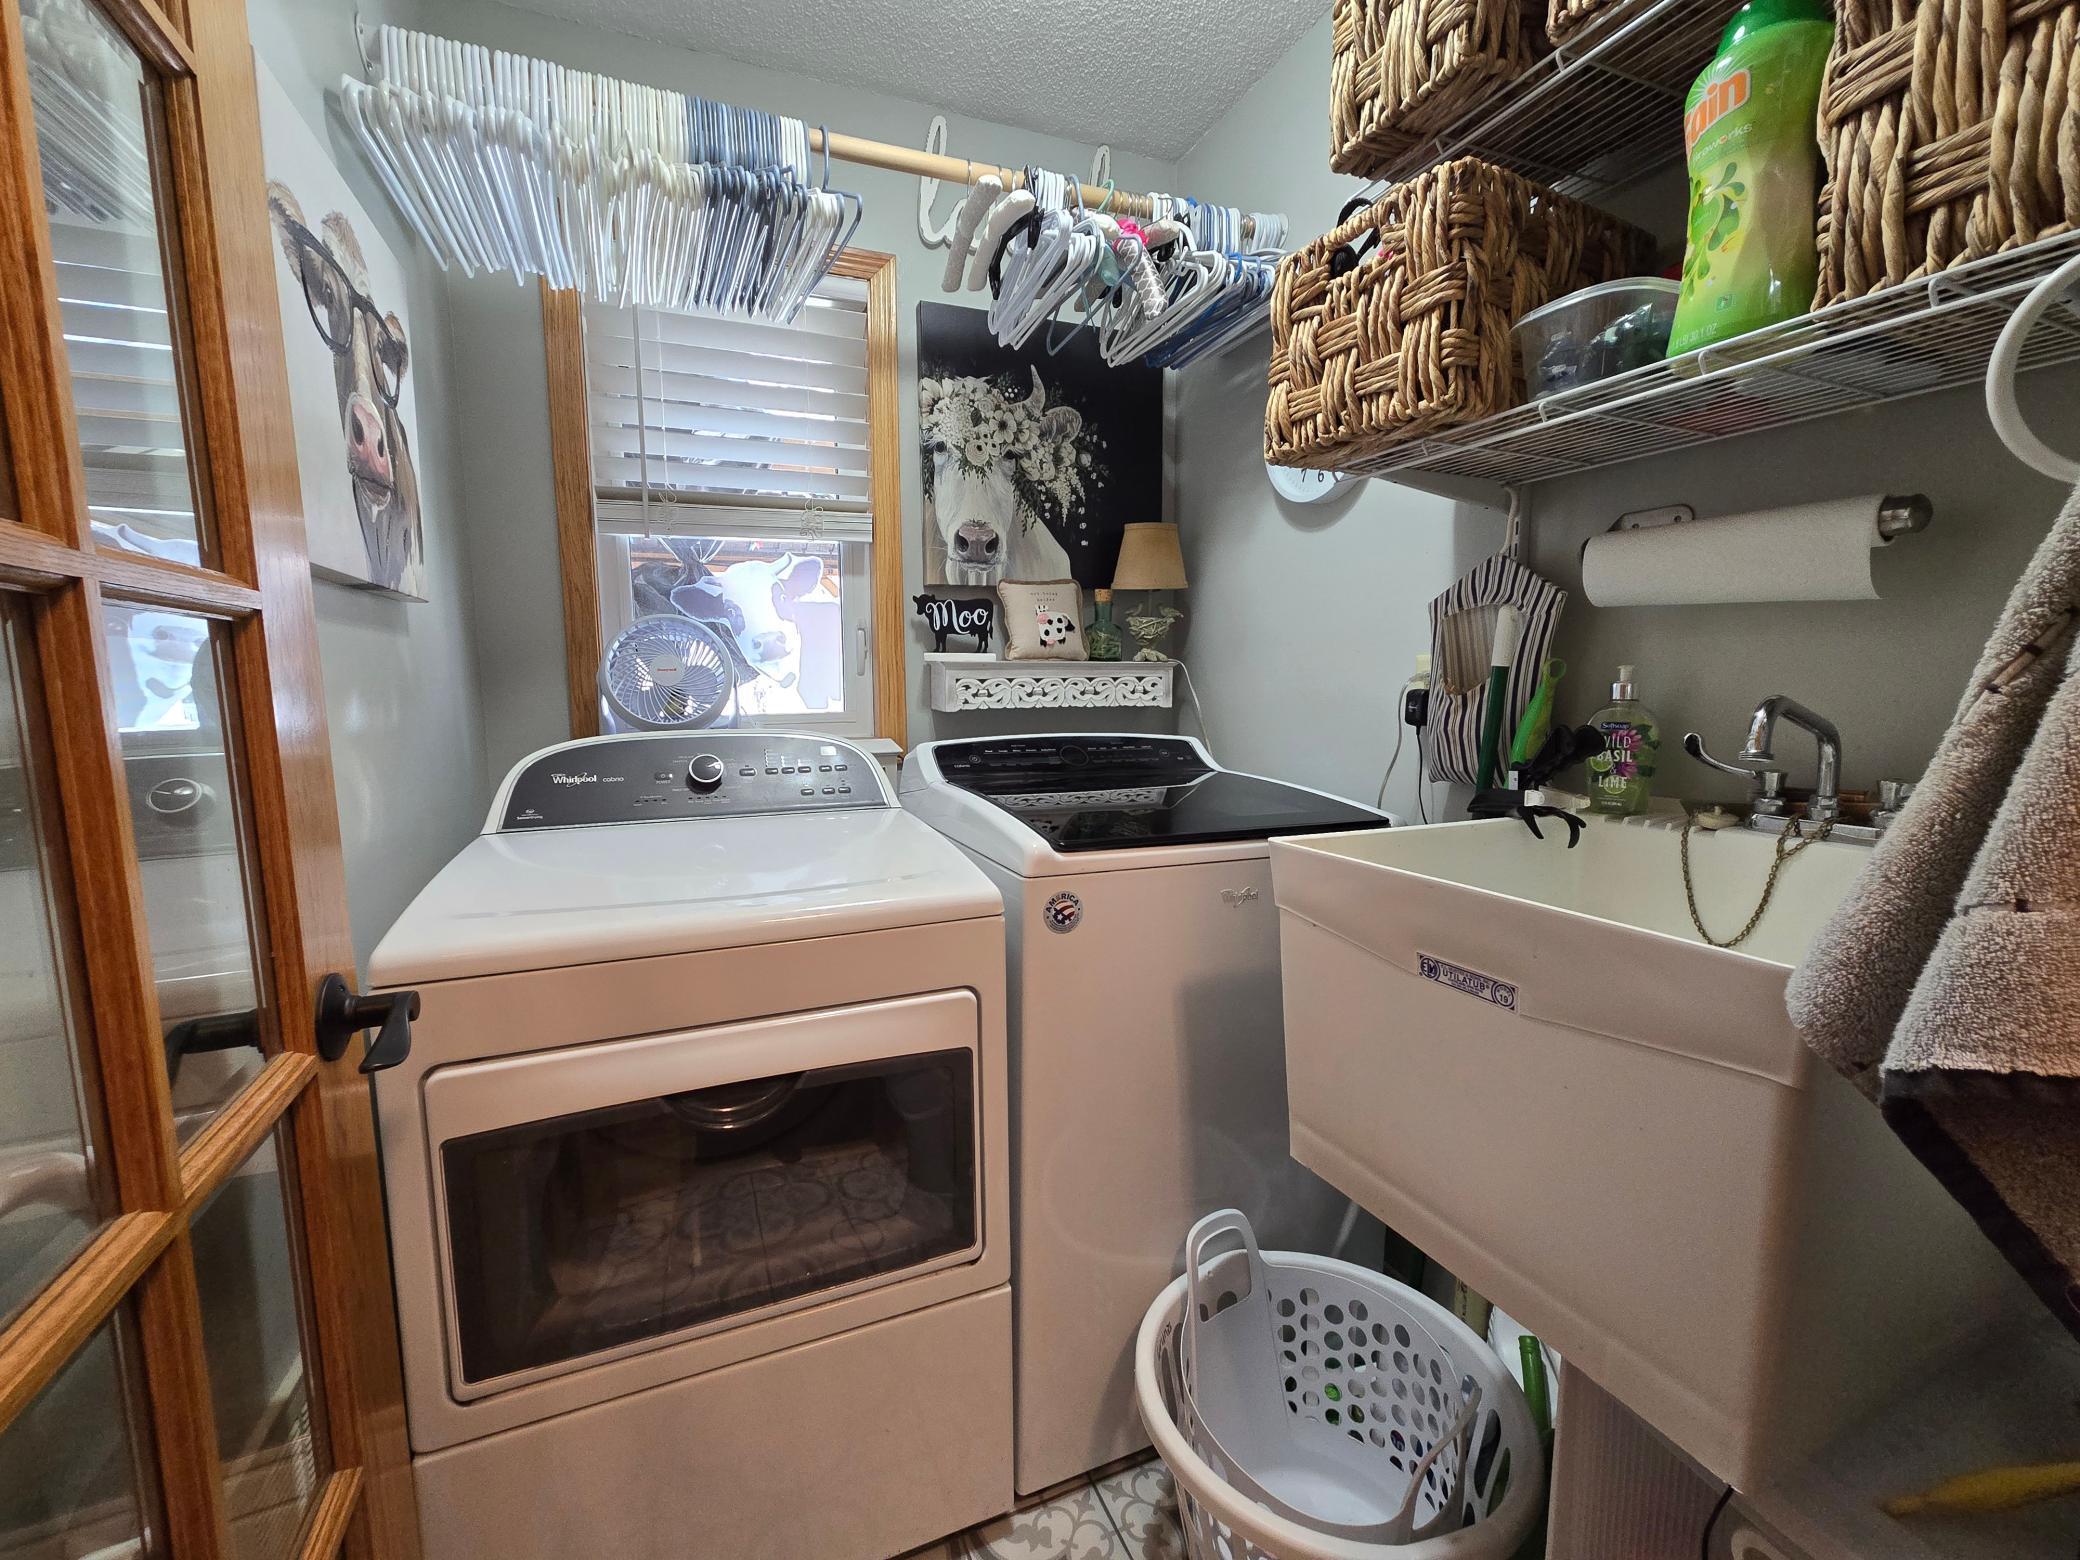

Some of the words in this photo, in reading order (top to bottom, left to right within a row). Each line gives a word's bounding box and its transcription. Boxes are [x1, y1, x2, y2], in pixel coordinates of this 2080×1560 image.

[1684, 70, 1751, 151] ain
[1317, 470, 1325, 483] 6
[925, 599, 989, 635] Moo
[551, 772, 597, 787] Whirlpool
[1598, 776, 1627, 789] LIME
